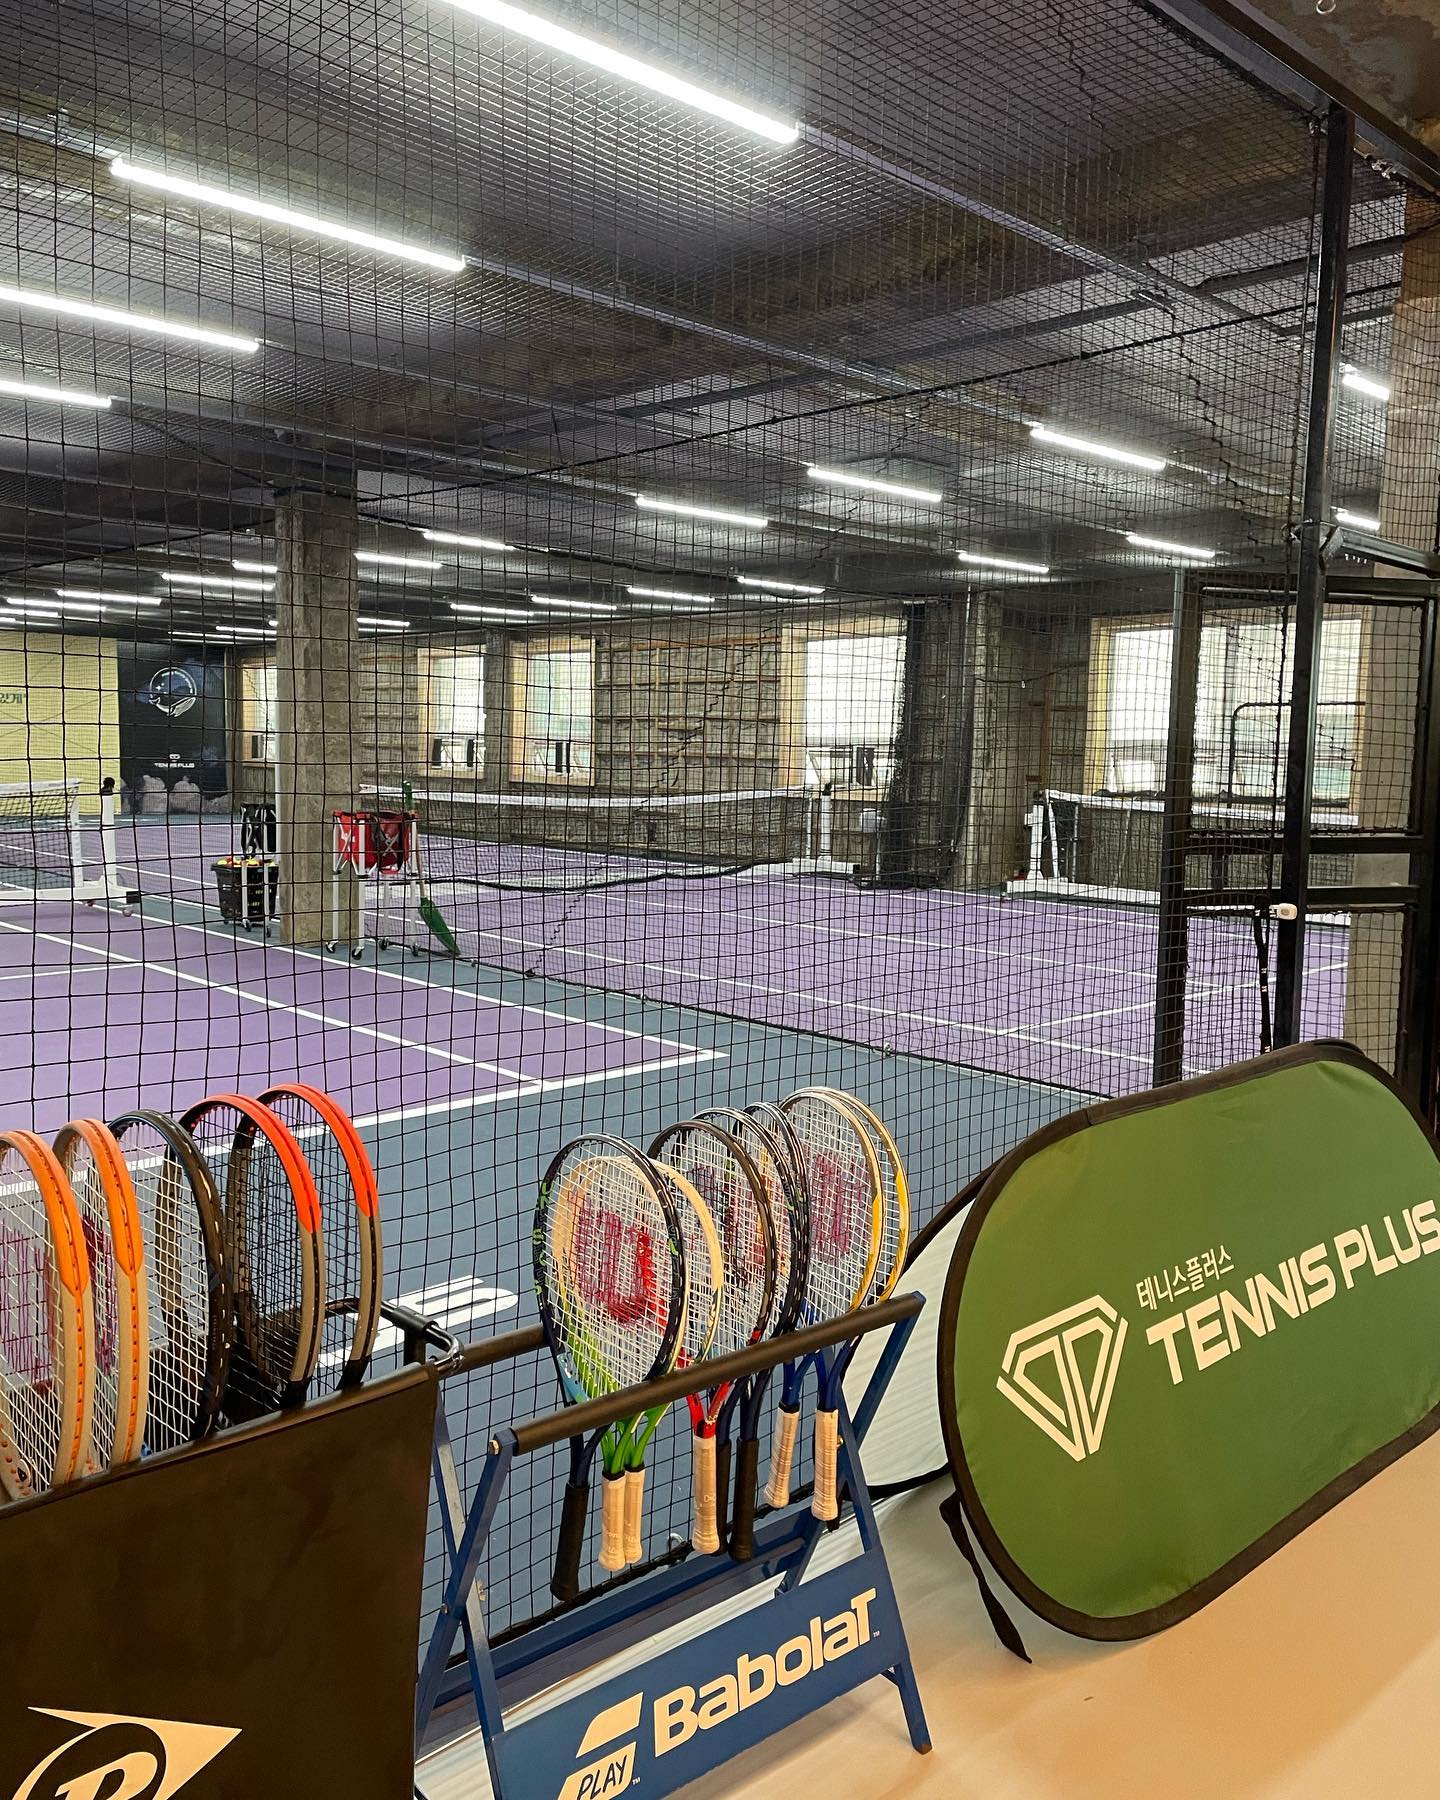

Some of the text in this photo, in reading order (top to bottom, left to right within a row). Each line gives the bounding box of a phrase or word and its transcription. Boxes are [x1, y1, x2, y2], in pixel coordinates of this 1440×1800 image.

[1136, 1244, 1235, 1311] 테니스플러스
[1145, 1199, 1440, 1385] TENNIS PLUS
[576, 1754, 628, 1800] PLAY
